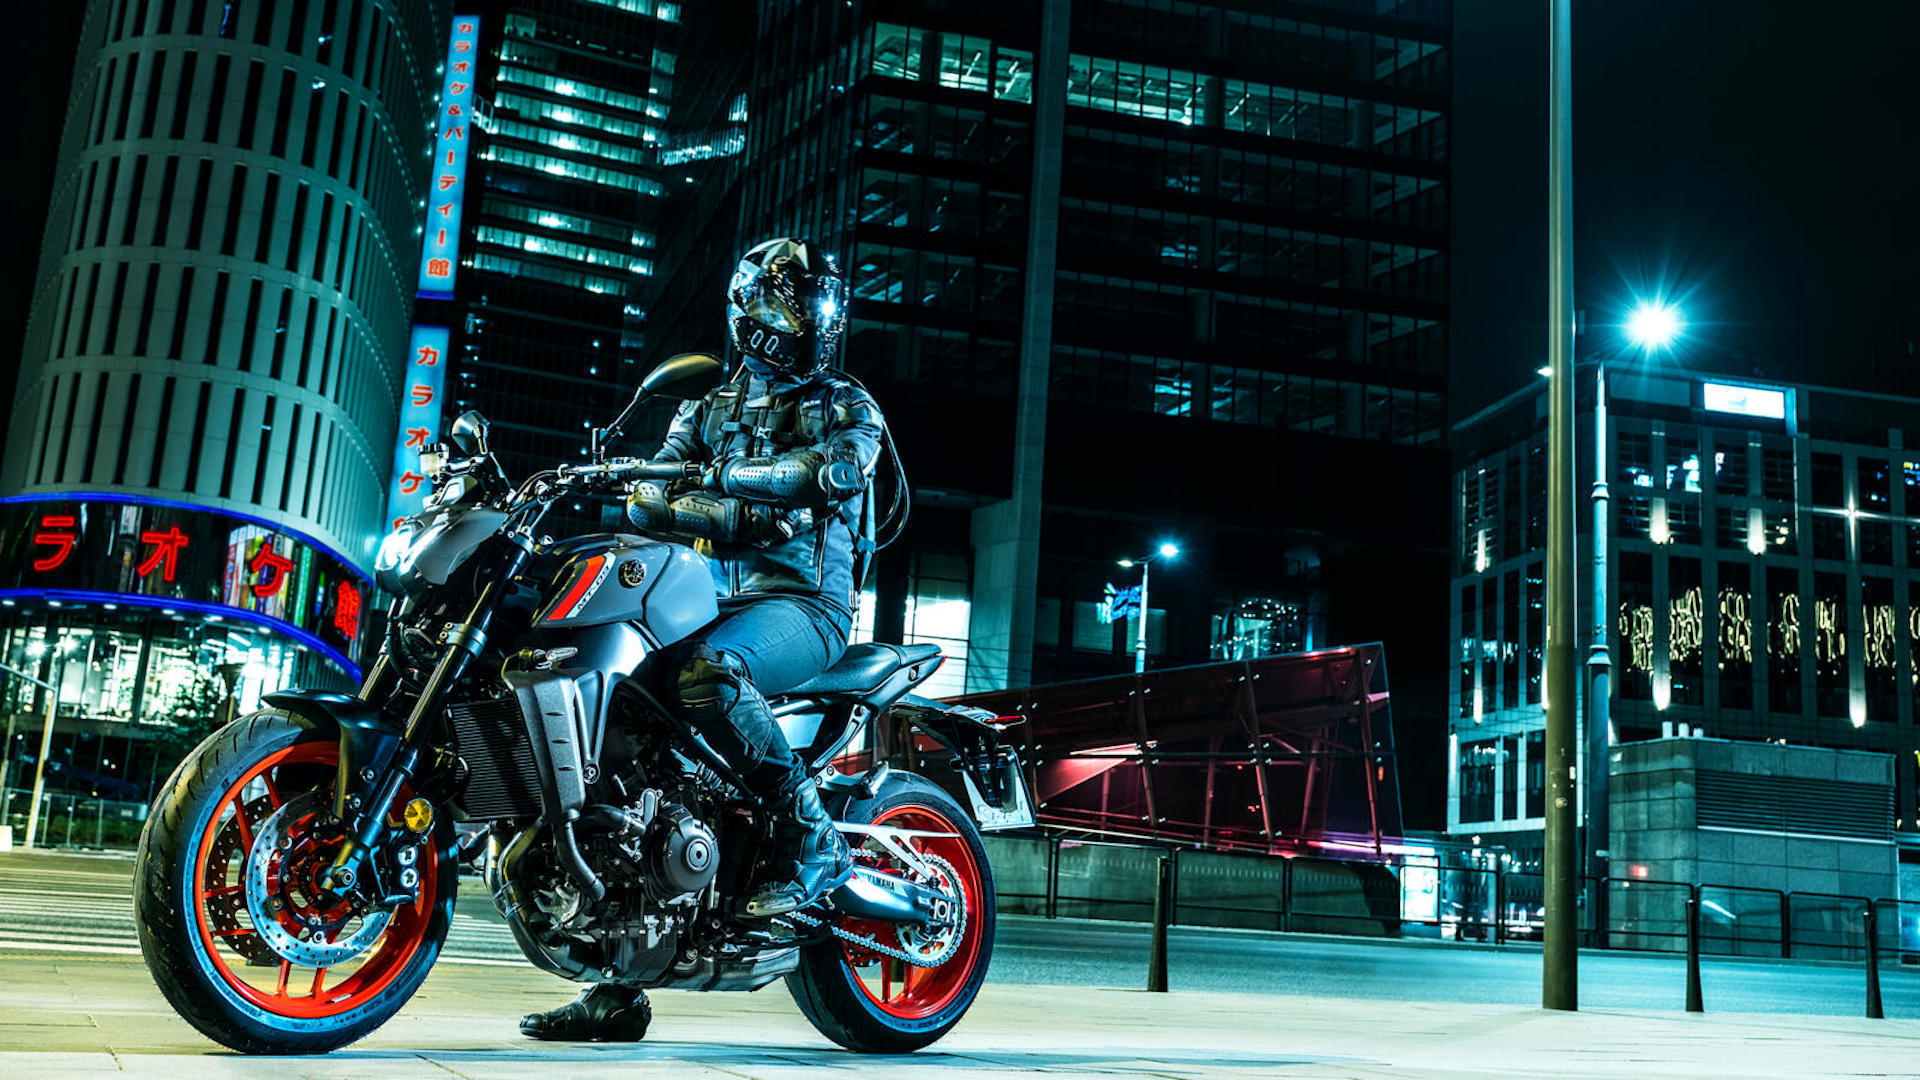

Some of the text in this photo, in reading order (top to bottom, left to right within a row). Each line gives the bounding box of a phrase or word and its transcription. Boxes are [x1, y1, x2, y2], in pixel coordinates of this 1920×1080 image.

[392, 345, 440, 531] カラオケ
[32, 514, 362, 640] ラオケ館
[866, 874, 895, 892] YAMAHA
